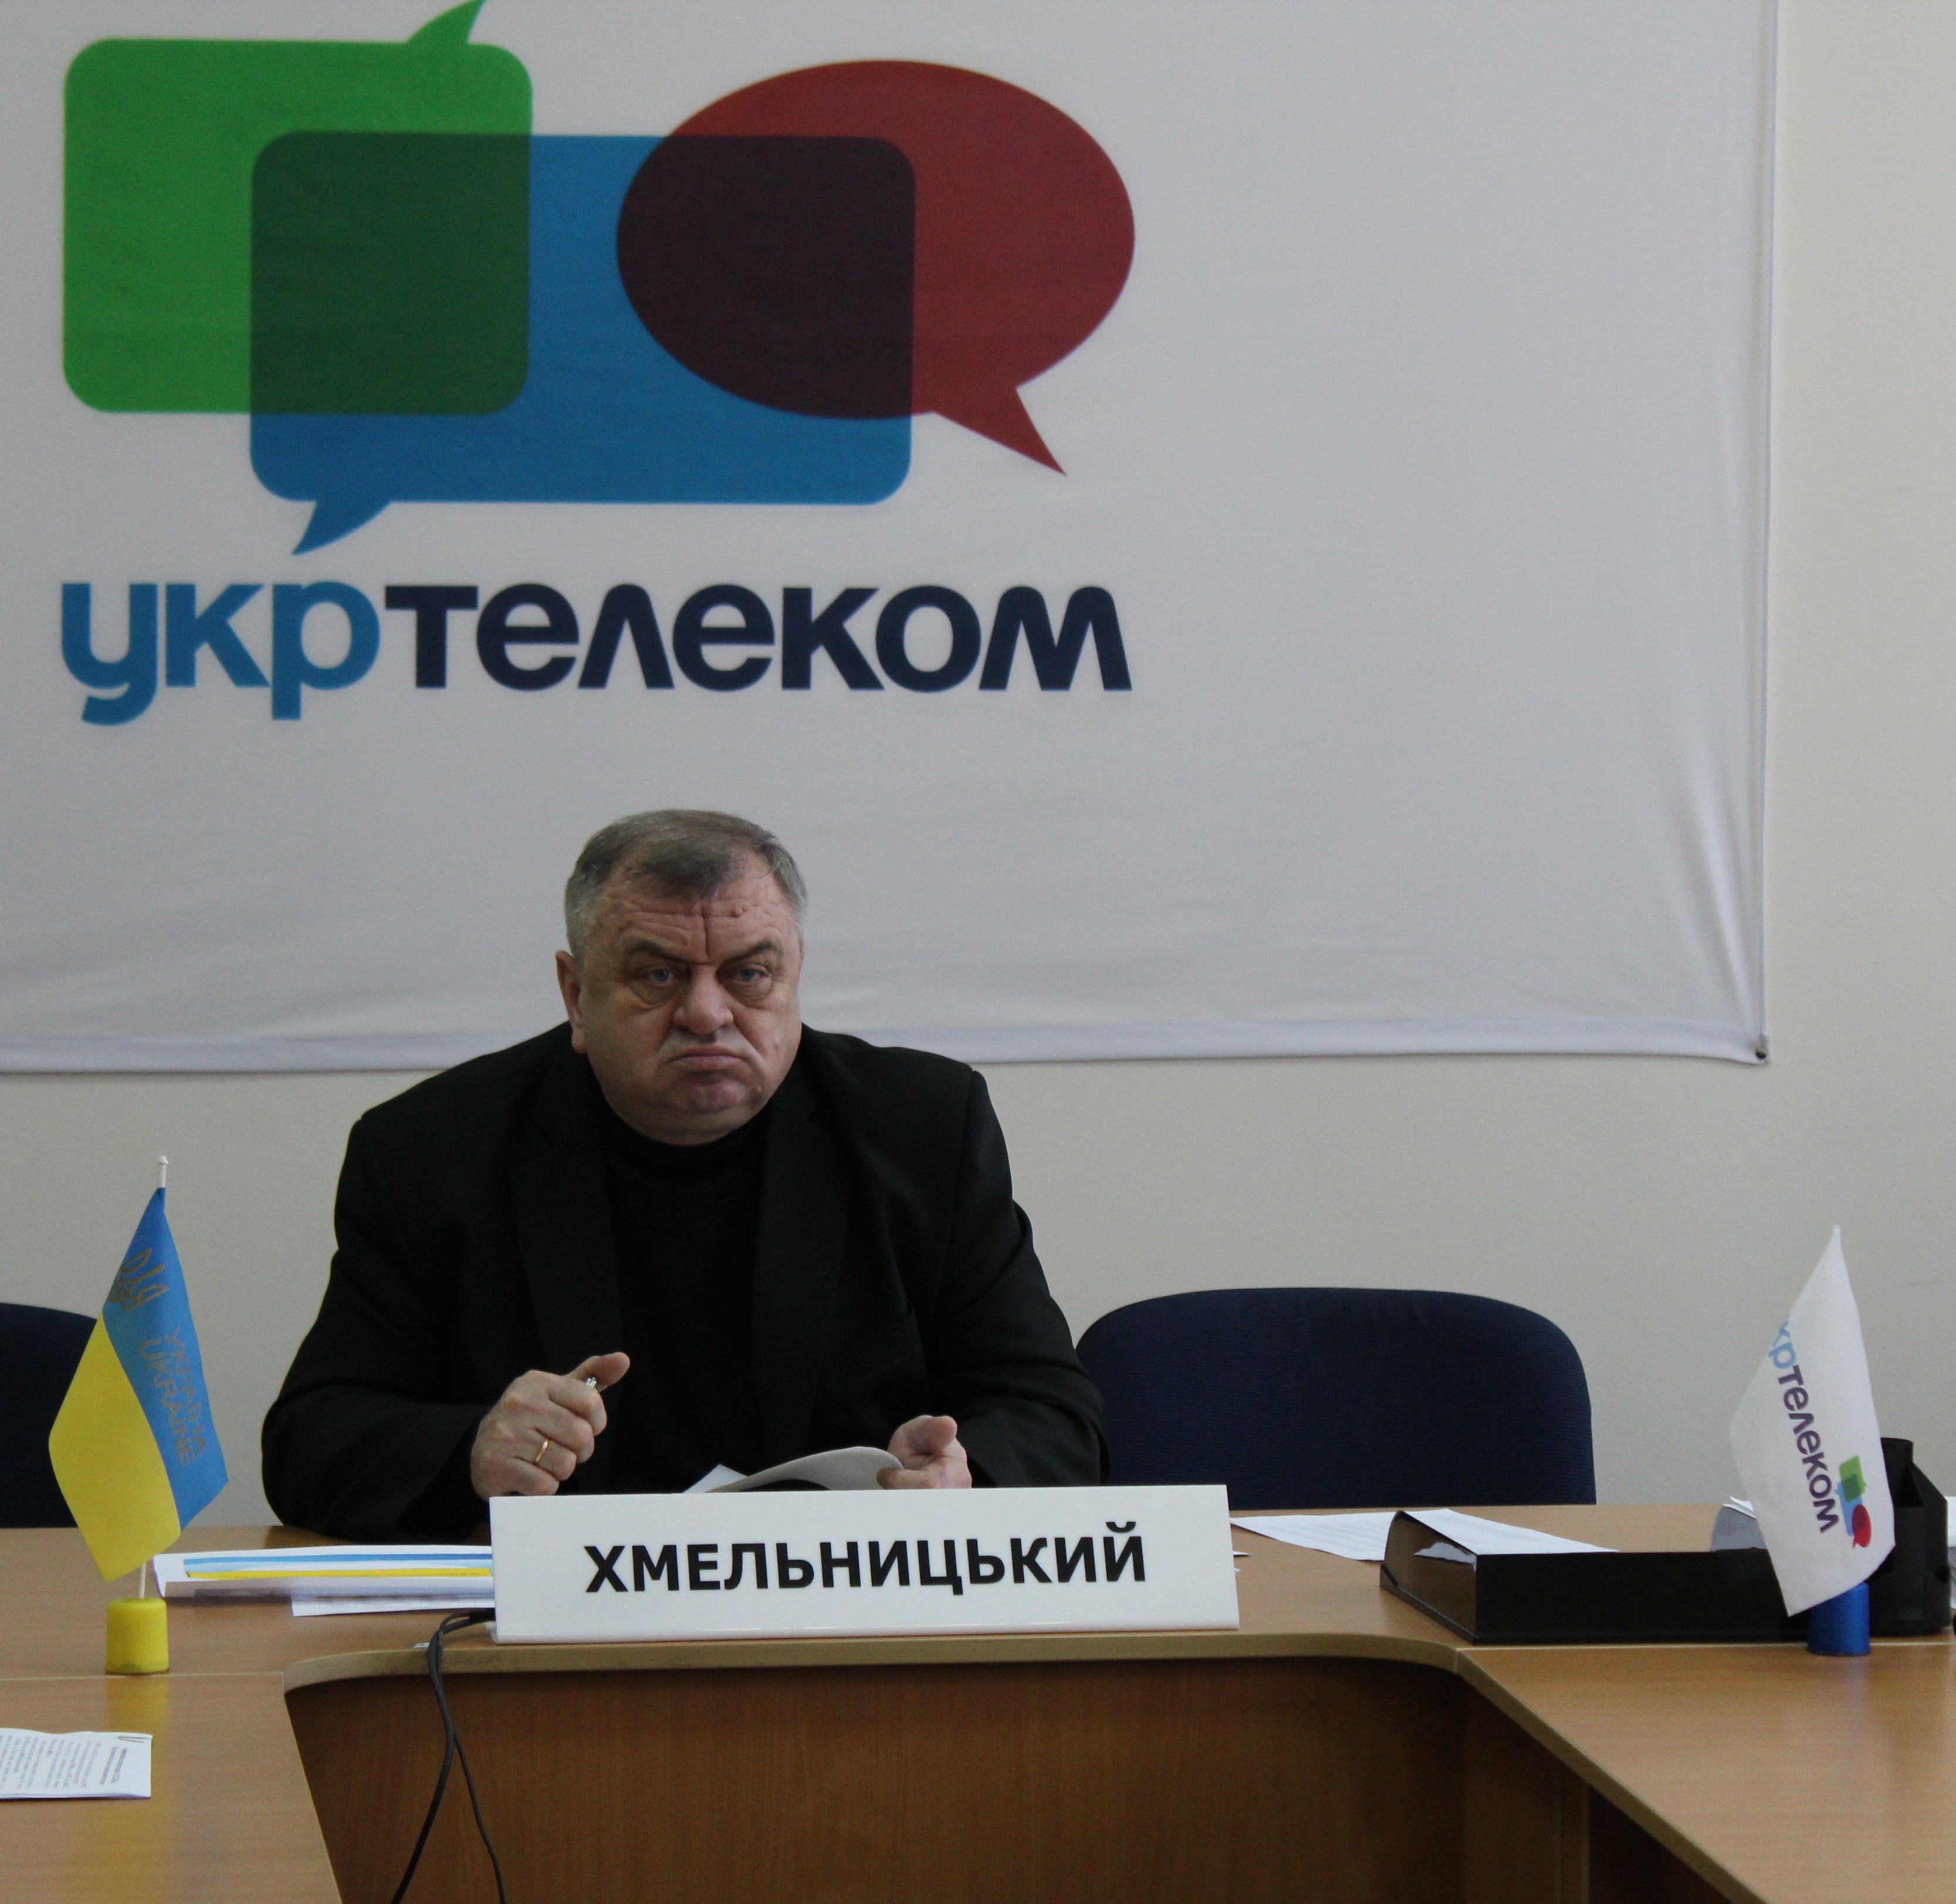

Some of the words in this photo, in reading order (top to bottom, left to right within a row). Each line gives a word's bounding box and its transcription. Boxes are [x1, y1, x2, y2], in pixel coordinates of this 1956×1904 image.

[61, 581, 1132, 725] укртелеком
[140, 1338, 195, 1467] UKRAINE
[1768, 1320, 1839, 1533] кртелеком
[584, 1521, 1145, 1595] ХМЕЛЬНИЦЬКИЙ
